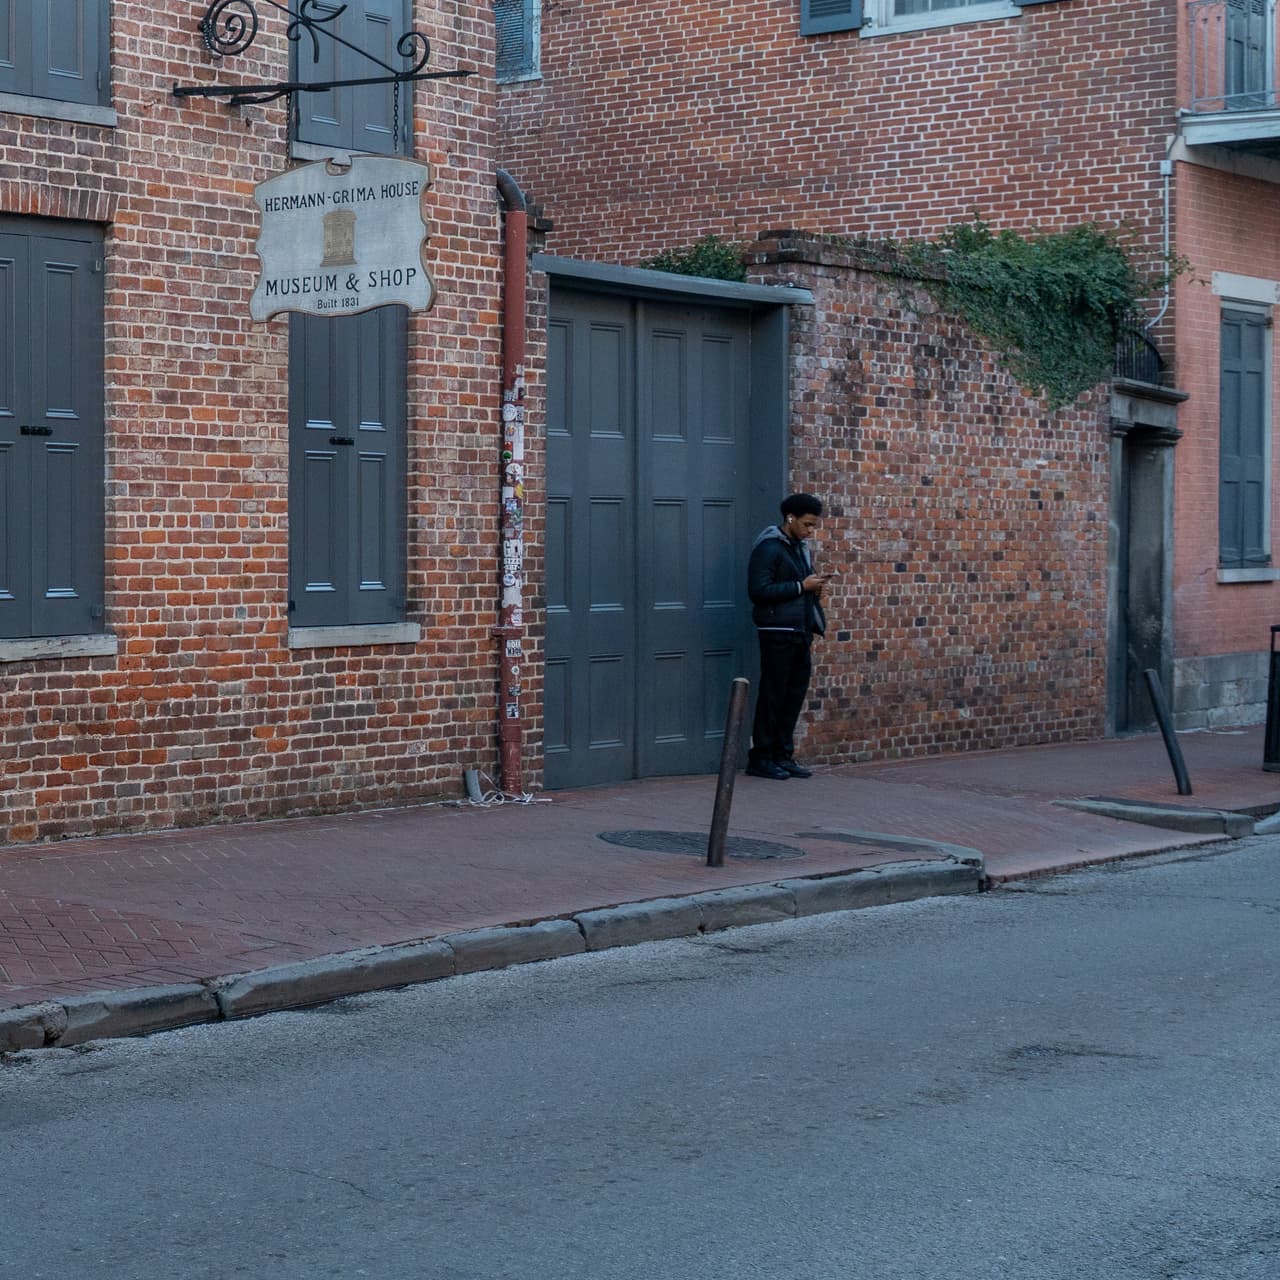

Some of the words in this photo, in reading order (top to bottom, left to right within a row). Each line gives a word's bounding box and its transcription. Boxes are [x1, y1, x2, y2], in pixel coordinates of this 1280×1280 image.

[381, 181, 419, 199] HOUSE
[266, 275, 337, 296] MUSEUM
[345, 273, 360, 293] &
[368, 268, 417, 288] SHOP
[317, 299, 337, 309] Built
[342, 297, 359, 308] 1831
